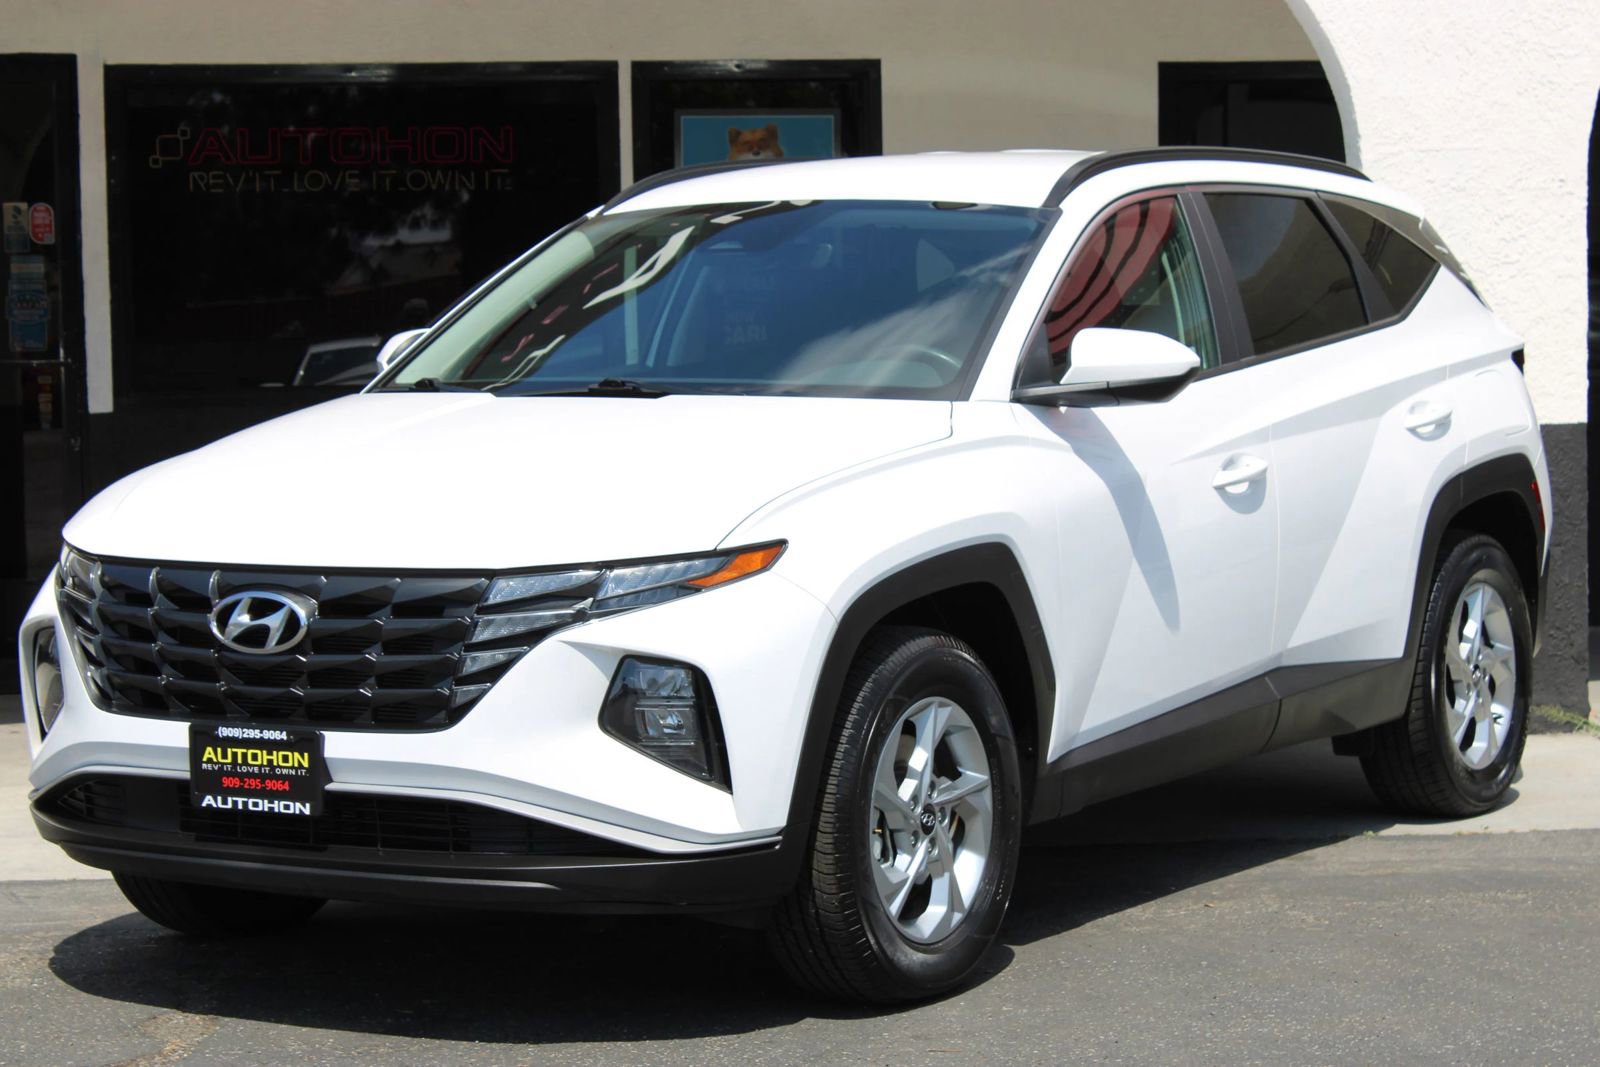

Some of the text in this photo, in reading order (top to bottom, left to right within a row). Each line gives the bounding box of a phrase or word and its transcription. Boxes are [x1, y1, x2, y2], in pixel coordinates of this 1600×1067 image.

[188, 126, 513, 166] AUTOHON
[293, 170, 361, 192] LOVE
[406, 169, 475, 191] OWN
[217, 726, 288, 741] (909)295-9064
[202, 746, 309, 768] AUTOHON
[237, 765, 259, 773] LOVE
[275, 768, 296, 776] OWN
[221, 776, 290, 792] 909-295-9064
[201, 795, 311, 815] AUTOHON
